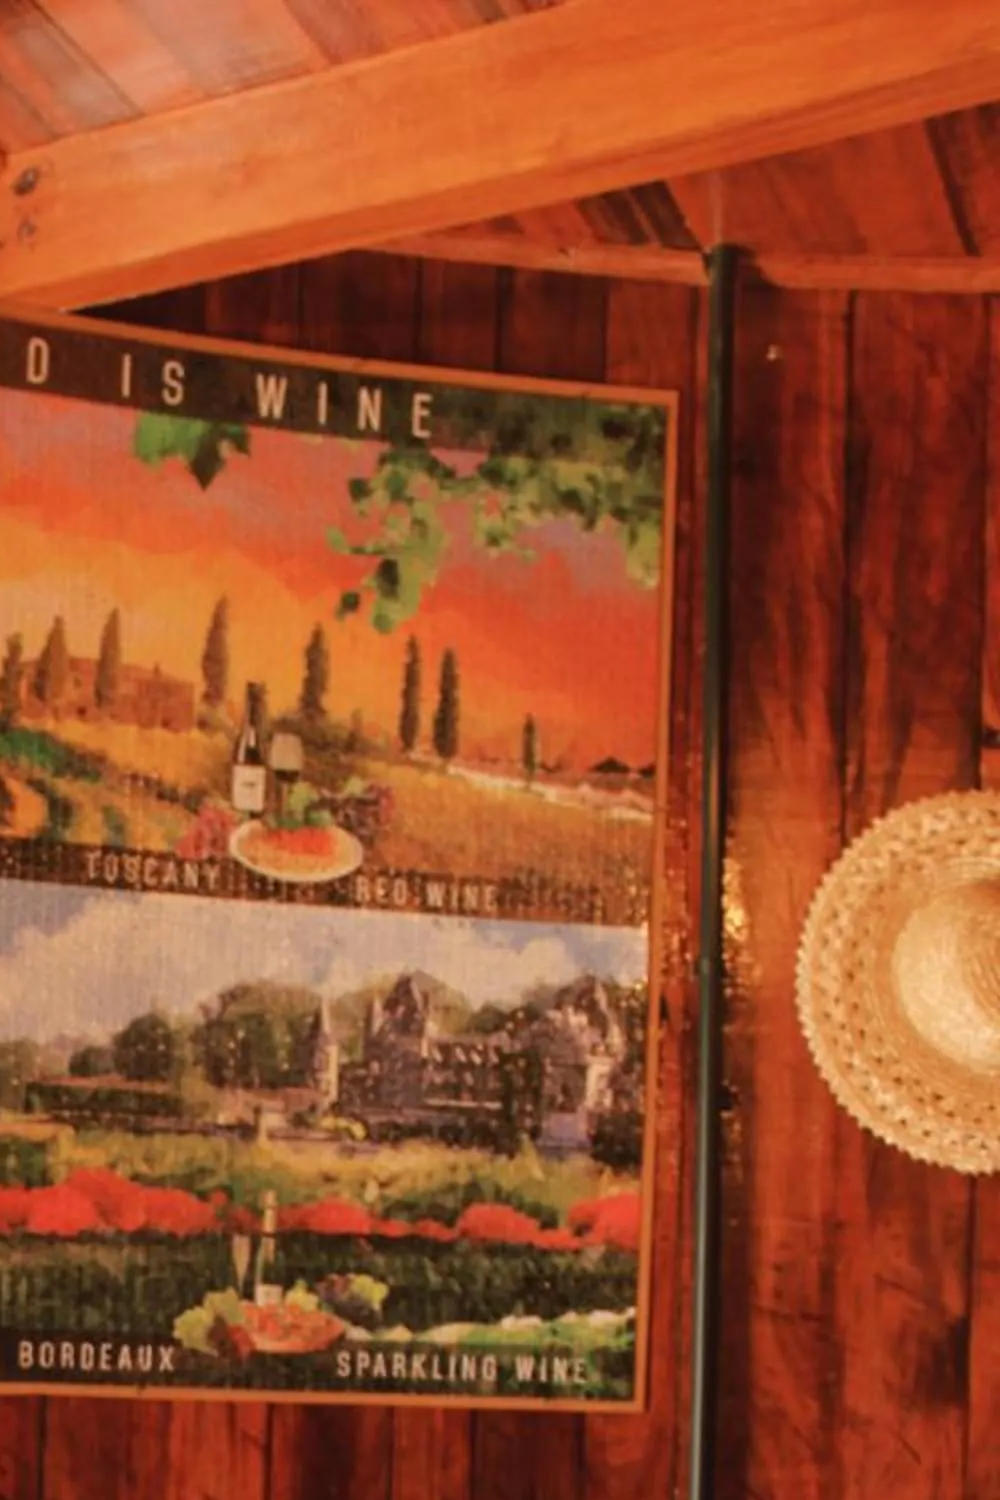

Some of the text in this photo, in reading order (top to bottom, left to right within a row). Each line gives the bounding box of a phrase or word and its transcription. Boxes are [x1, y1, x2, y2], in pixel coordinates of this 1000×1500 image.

[121, 353, 185, 405] IS
[256, 373, 433, 438] WINE
[85, 851, 220, 890] TOSCANY
[355, 874, 498, 911] RED WINE
[18, 1339, 174, 1372] BORDEAUX
[336, 1351, 588, 1384] SPARKLING WINE
